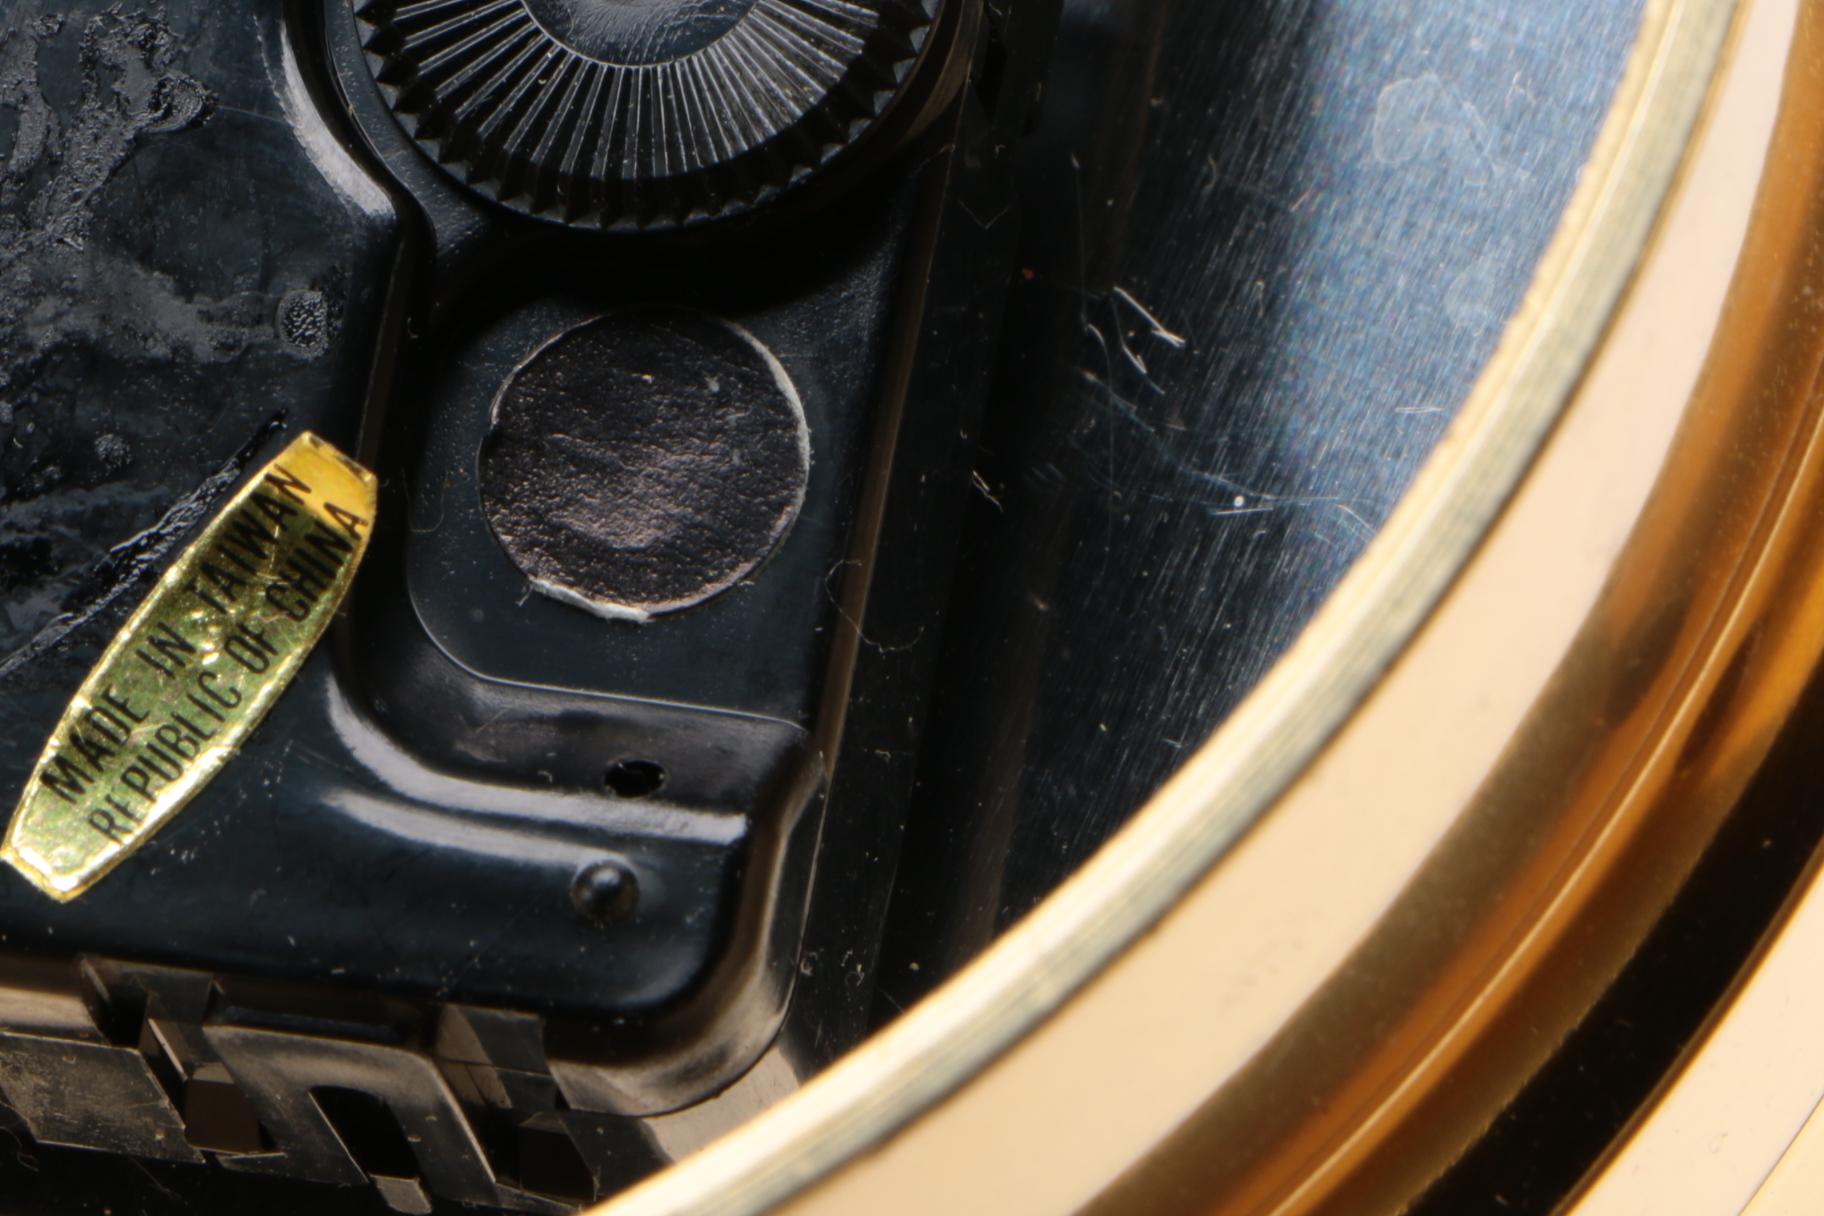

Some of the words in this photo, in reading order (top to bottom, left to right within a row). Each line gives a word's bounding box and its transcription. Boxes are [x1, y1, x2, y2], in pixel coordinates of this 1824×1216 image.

[39, 686, 151, 805] MADE
[135, 620, 197, 681] IN
[186, 462, 314, 615] TAIWAN
[86, 670, 243, 846] REPUBLIC
[222, 620, 284, 676] OF
[264, 500, 370, 624] CHINA
